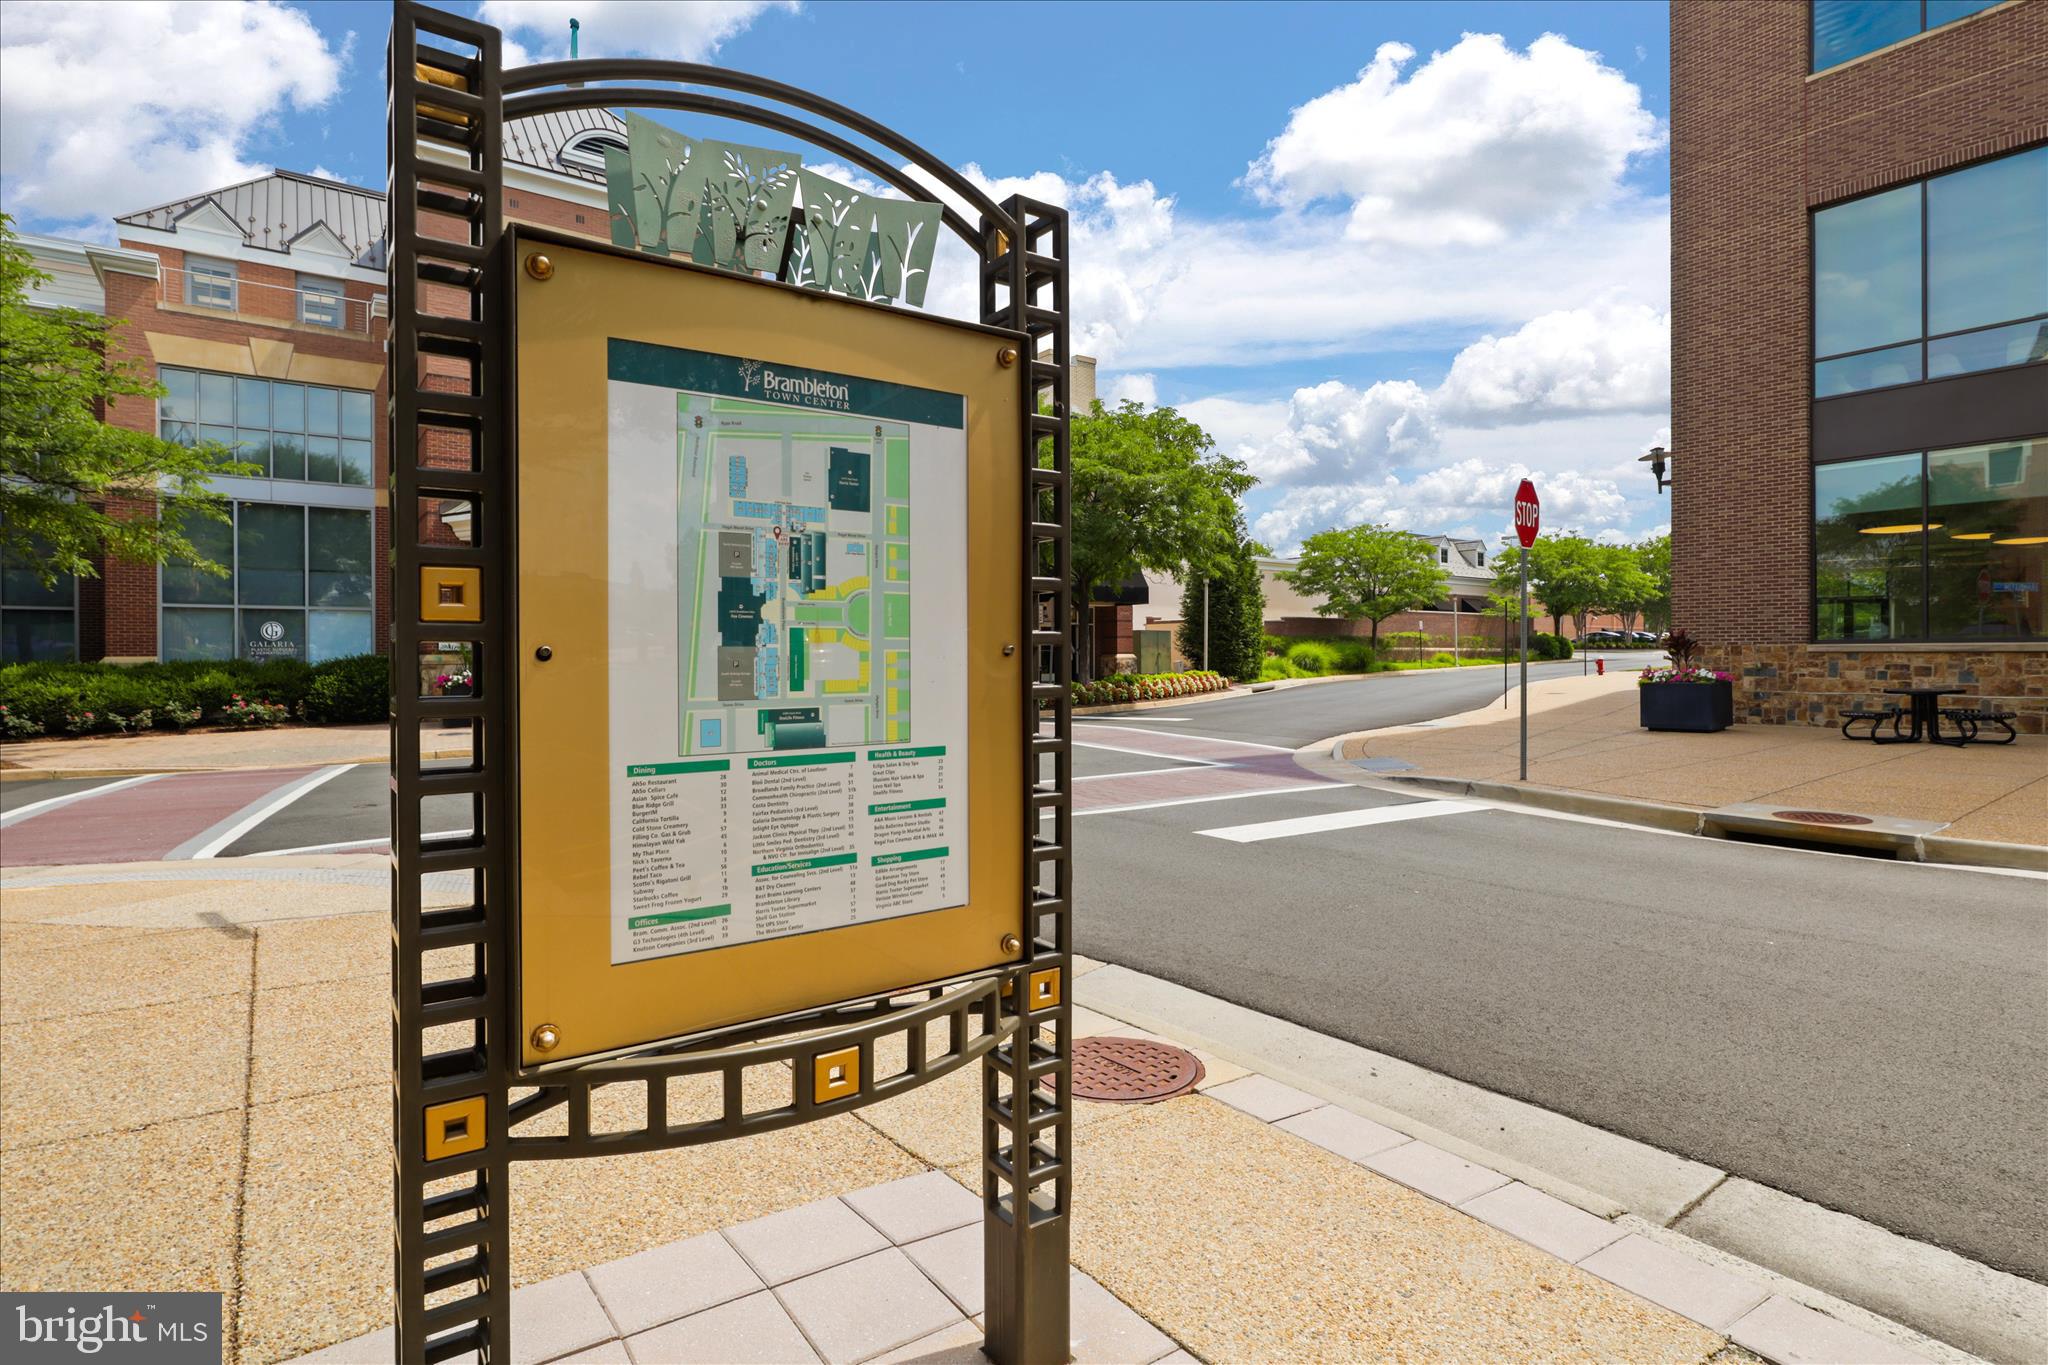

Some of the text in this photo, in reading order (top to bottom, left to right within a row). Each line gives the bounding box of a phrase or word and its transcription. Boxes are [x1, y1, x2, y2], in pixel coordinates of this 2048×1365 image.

[763, 370, 849, 401] Brambleton
[763, 389, 851, 410] TOWN CENTER
[1516, 501, 1538, 528] STOP
[634, 767, 656, 775] Dining
[664, 822, 688, 830] Creamery
[633, 841, 661, 850] Himalayan
[635, 918, 658, 927] Offices
